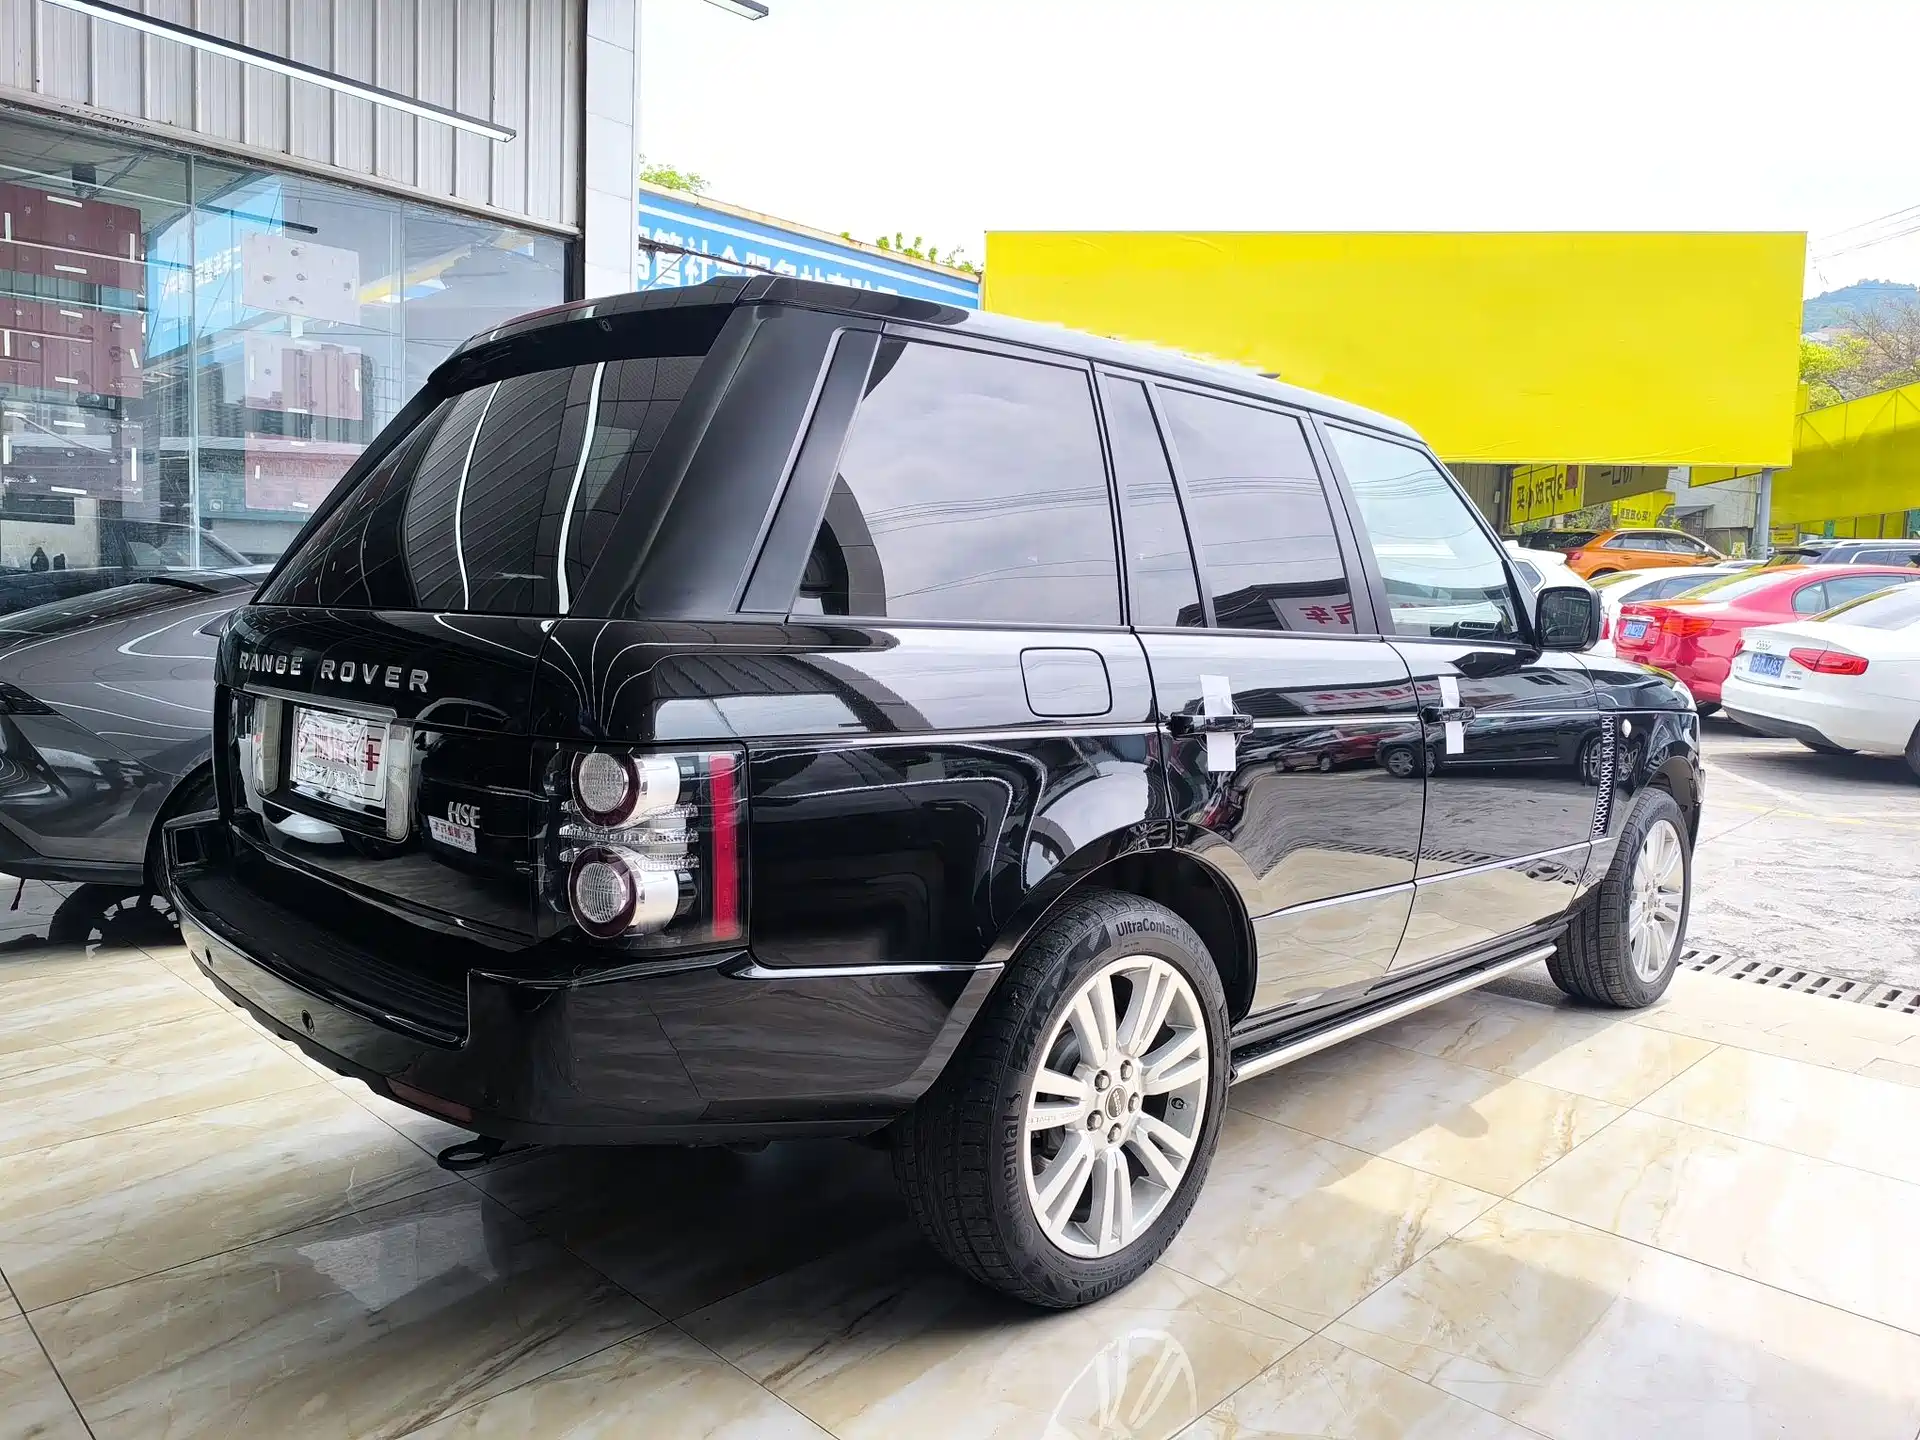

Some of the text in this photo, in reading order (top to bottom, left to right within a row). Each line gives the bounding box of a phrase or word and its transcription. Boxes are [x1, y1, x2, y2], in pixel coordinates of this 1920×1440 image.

[239, 651, 430, 693] RANGE ROVER
[447, 801, 481, 829] HSE
[1116, 917, 1180, 940] UltraContact
